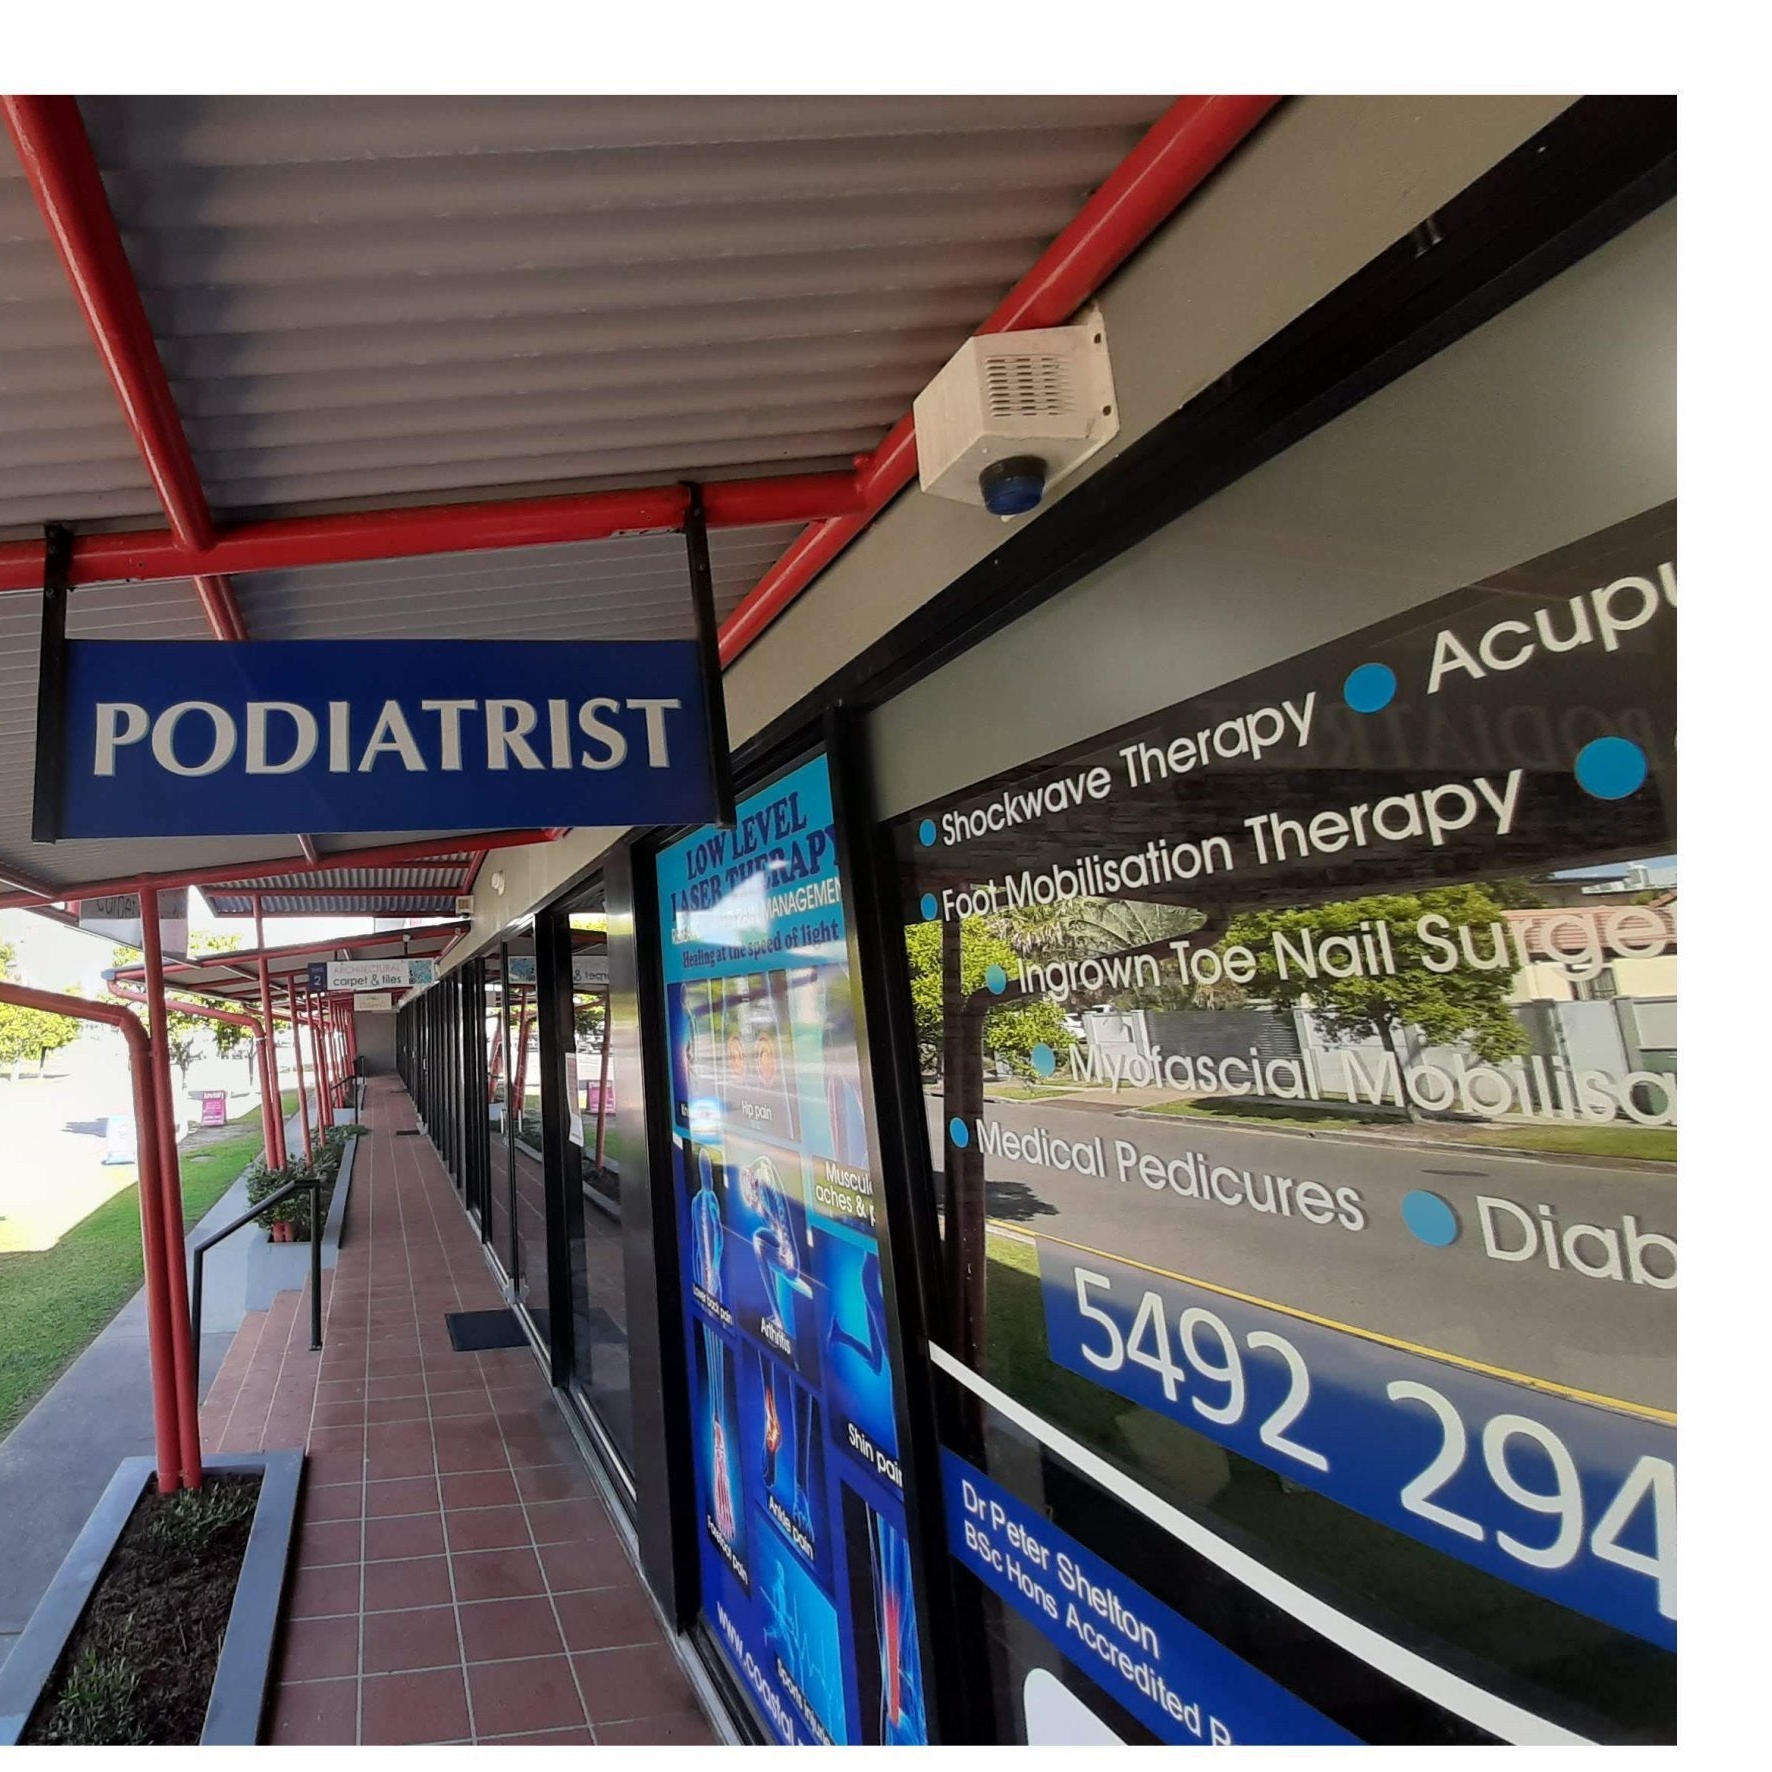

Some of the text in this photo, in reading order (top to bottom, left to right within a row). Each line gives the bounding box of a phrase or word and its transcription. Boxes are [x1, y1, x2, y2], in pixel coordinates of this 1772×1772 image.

[93, 698, 682, 777] PODIATRIST
[942, 691, 1316, 847] Shockwave Therapy
[686, 792, 807, 880] LOW LEVEL
[942, 769, 1523, 922] Foot Mobilisation Therapy
[671, 873, 723, 921] LASER
[683, 919, 840, 968] Healing at the speed of light
[1017, 905, 1668, 1002] Ingrown Toe Nail Surge
[313, 975, 322, 986] 2
[333, 974, 402, 987] carpet & tiles
[741, 1100, 772, 1121] Hip pain
[1069, 1044, 1677, 1127] Myofascial Mobilisa
[816, 1185, 852, 1213] aches
[856, 1195, 867, 1218] &
[975, 1122, 1677, 1290] Medical Pedicures Diab
[720, 1307, 733, 1328] pain
[760, 1317, 791, 1354] Arthritis
[848, 1423, 874, 1460] Shin
[1072, 1267, 1677, 1620] 5492 294
[769, 1496, 814, 1560] Ankle pain
[732, 1554, 748, 1585] pain
[962, 1479, 1161, 1659] Dr Peter Shelton
[964, 1520, 1003, 1573] BSc
[1007, 1555, 1059, 1620] Hons
[1066, 1602, 1202, 1738] Accredited
[777, 1658, 803, 1710] Sports
